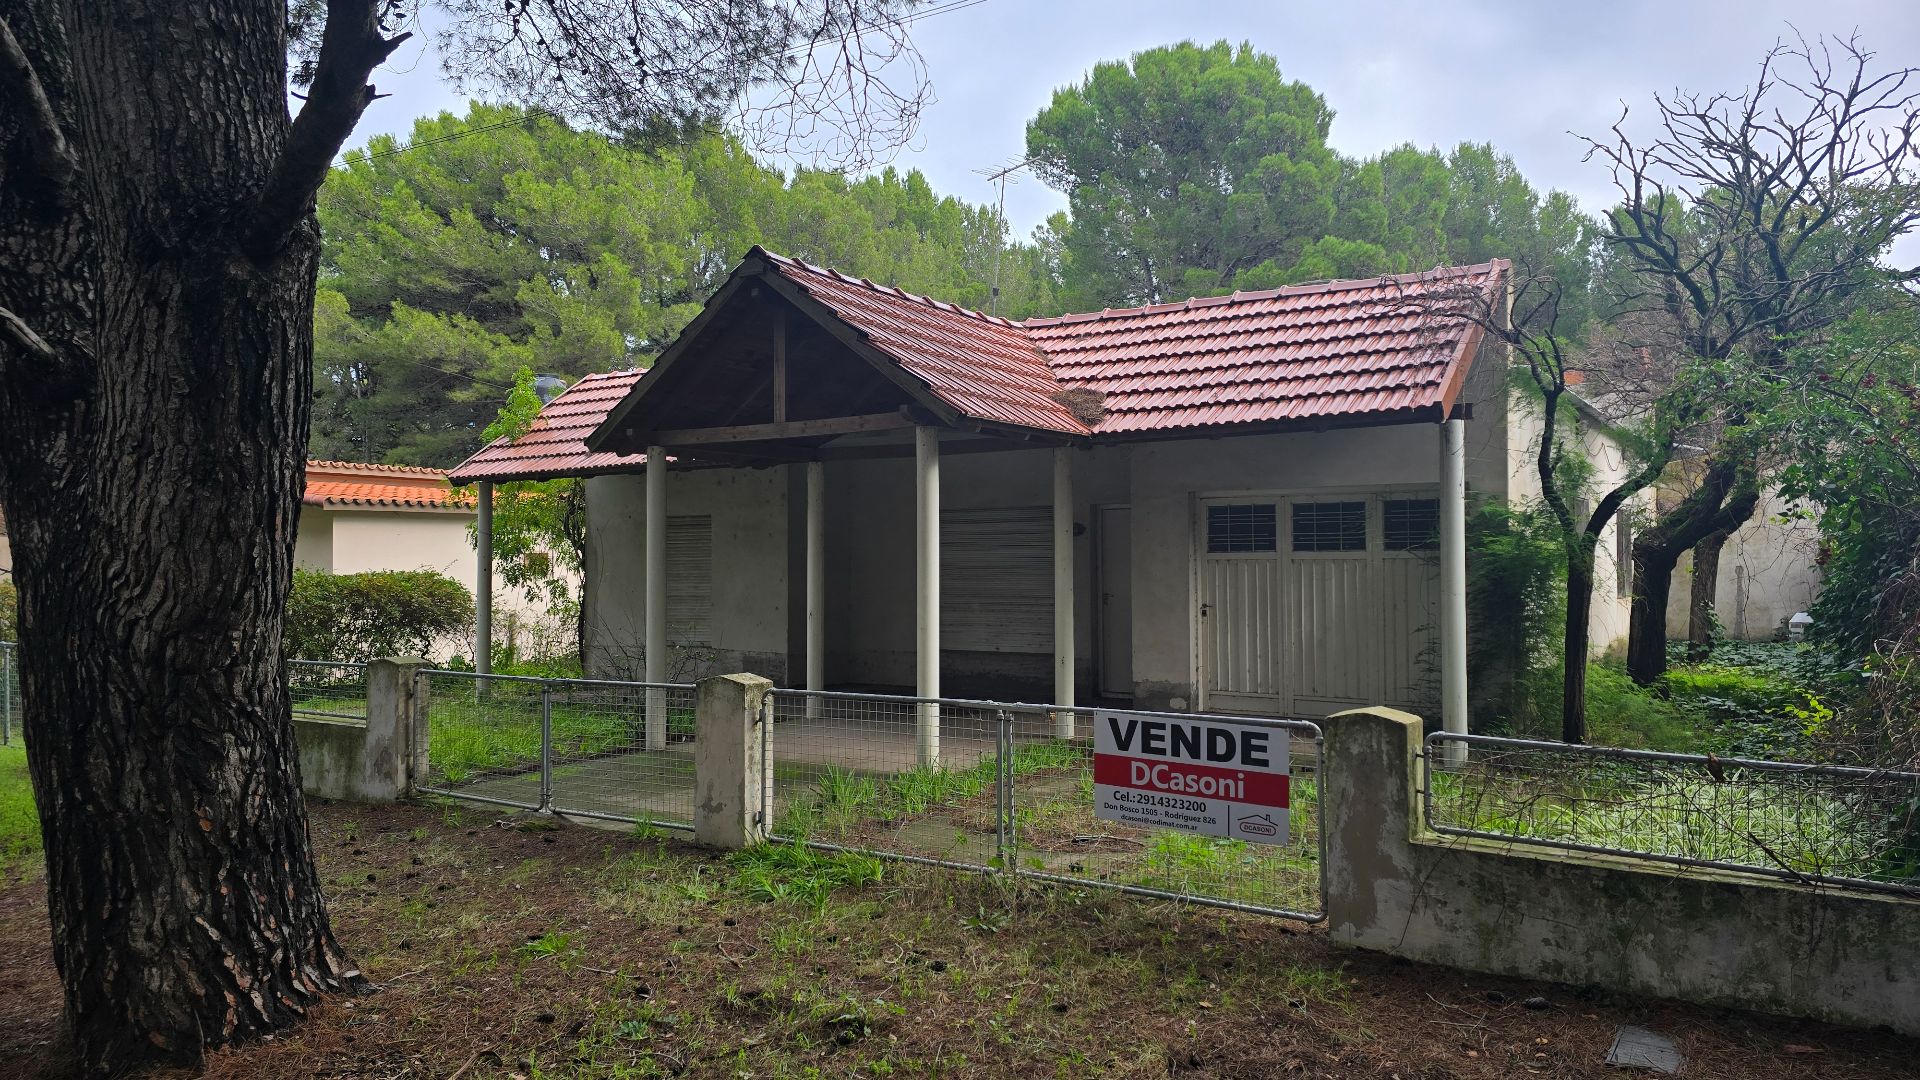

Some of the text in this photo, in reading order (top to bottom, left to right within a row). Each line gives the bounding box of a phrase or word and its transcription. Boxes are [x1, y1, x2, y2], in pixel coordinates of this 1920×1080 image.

[1107, 717, 1270, 768] VENDE
[1131, 760, 1244, 800] DCasoni
[1104, 802, 1118, 811] Don
[1119, 804, 1140, 814] Bosco
[1141, 807, 1158, 817] 1505
[1202, 817, 1217, 825] 826
[1120, 814, 1198, 831] dcasoni@codimat.com.ar
[1243, 824, 1272, 834] DCASONI
